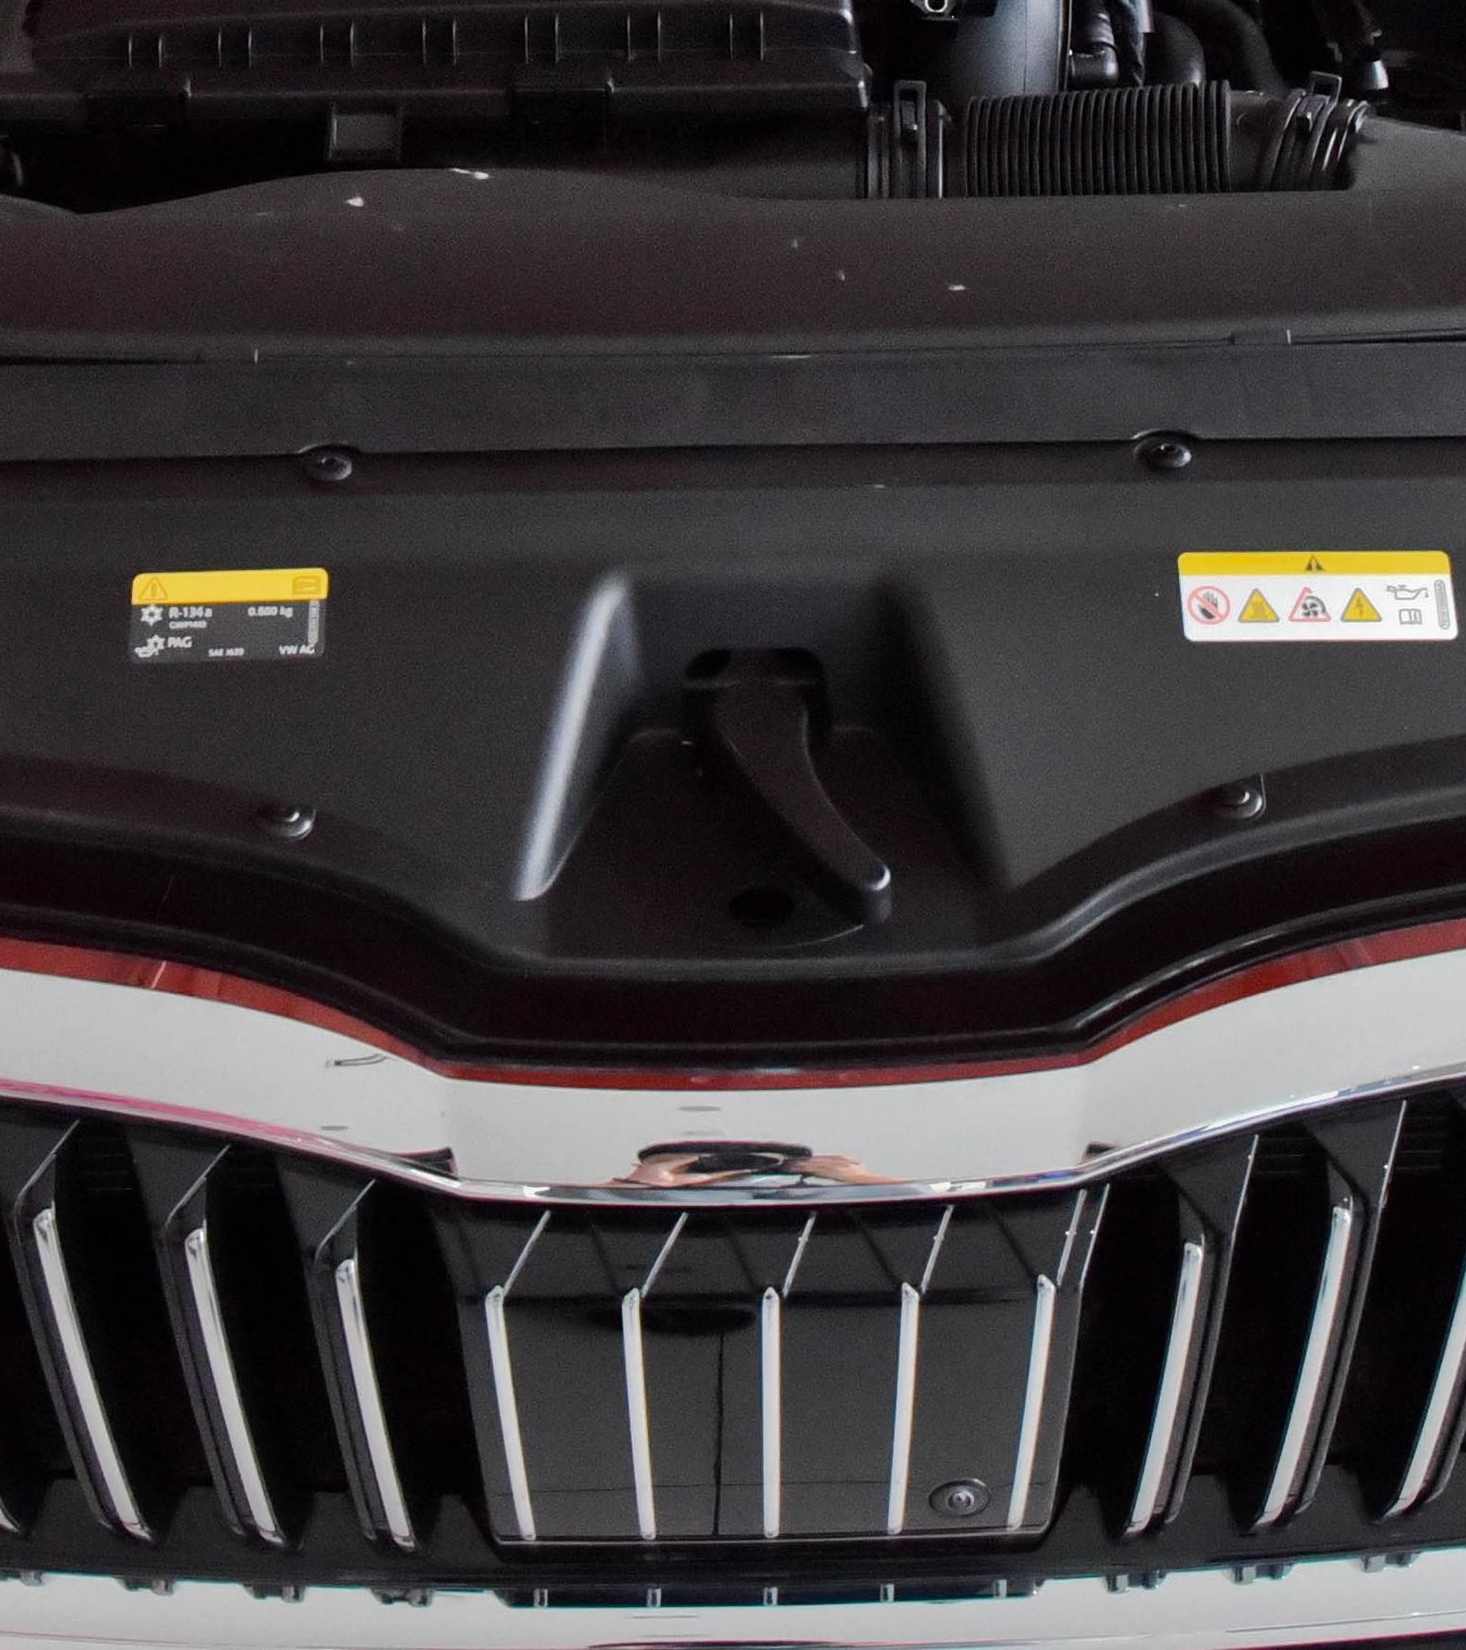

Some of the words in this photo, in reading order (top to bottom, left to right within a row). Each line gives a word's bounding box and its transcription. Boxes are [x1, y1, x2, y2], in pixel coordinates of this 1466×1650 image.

[167, 636, 193, 649] PAG
[278, 644, 298, 655] VW
[299, 644, 316, 654] AG
